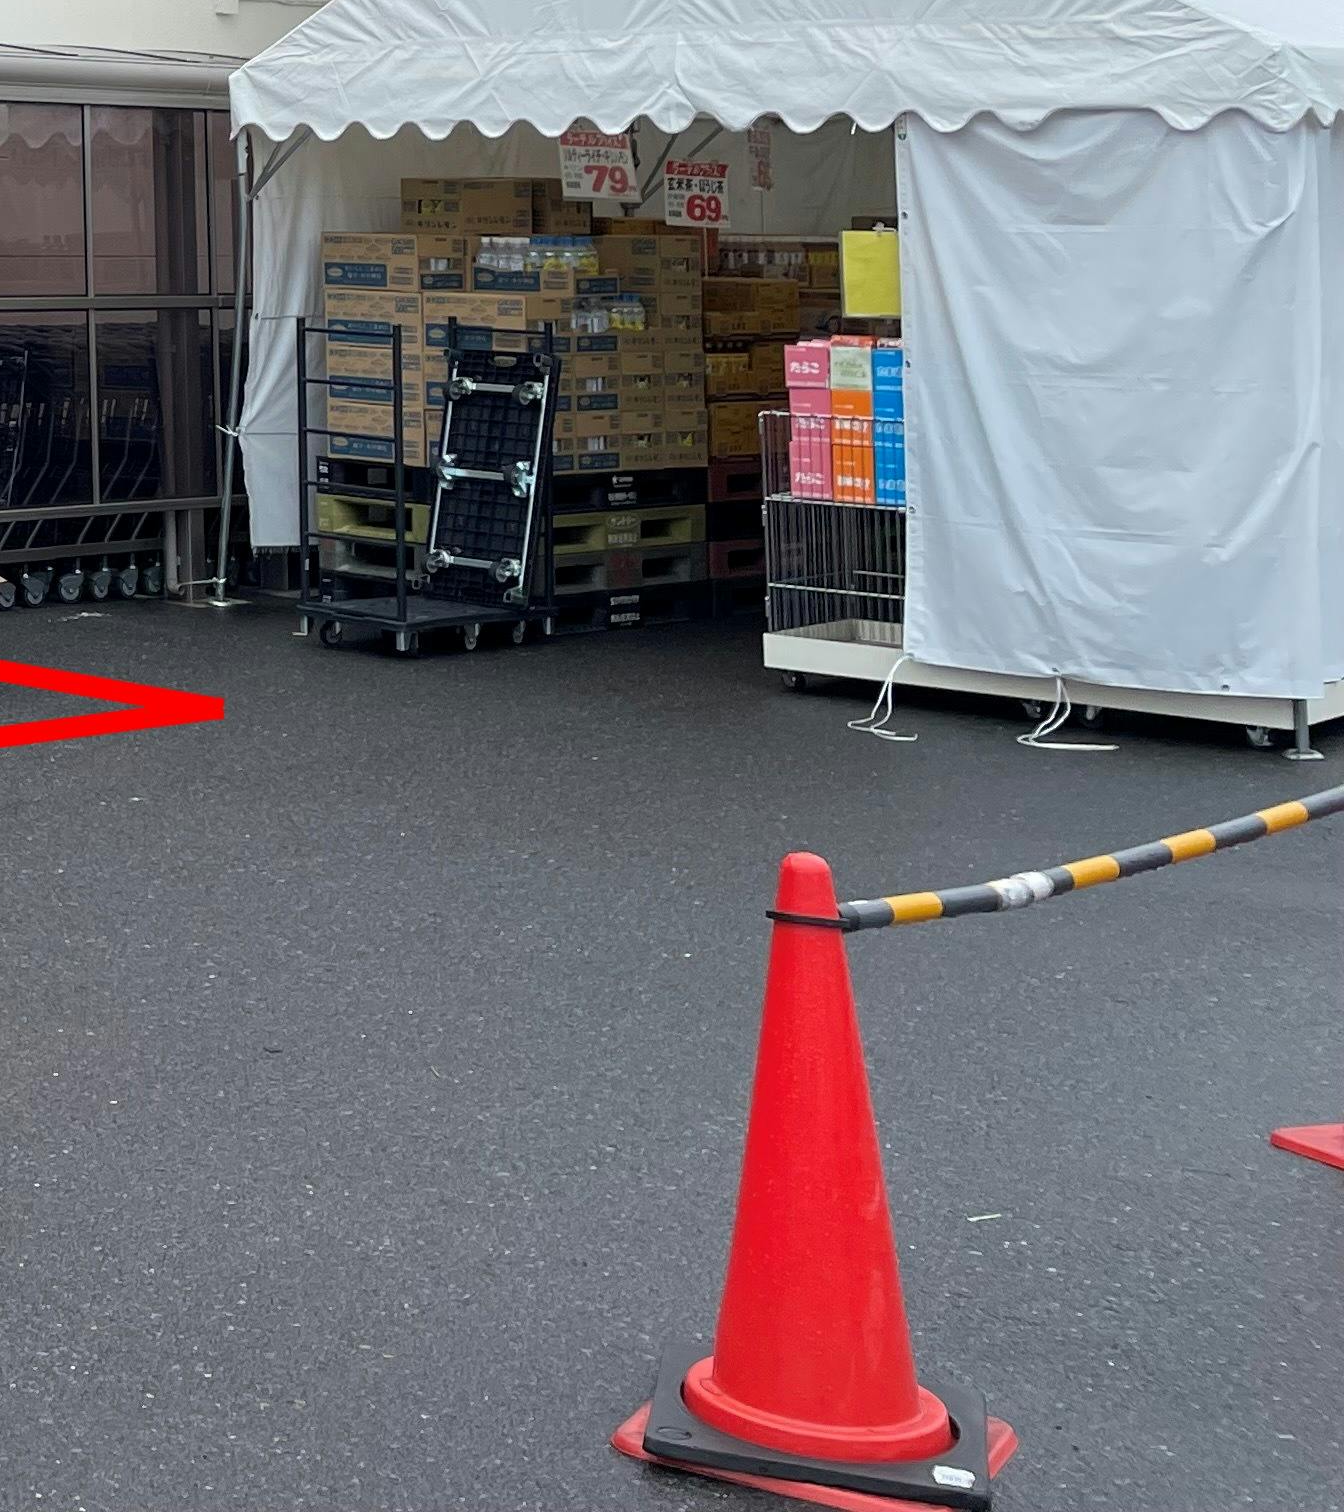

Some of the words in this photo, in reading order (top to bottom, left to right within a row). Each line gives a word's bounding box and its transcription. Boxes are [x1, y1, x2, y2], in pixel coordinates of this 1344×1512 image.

[583, 165, 629, 193] 79
[686, 194, 722, 222] 69
[789, 361, 820, 374] たらこ
